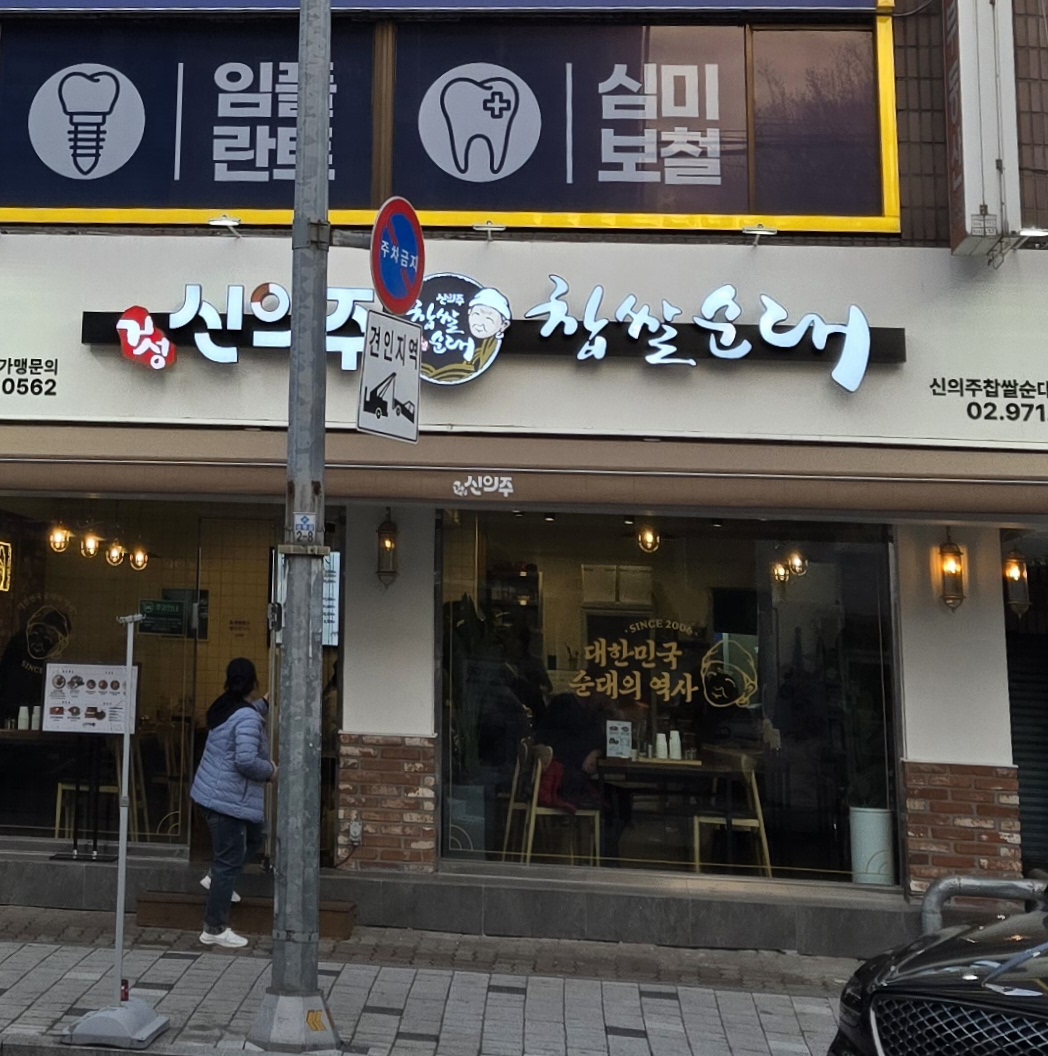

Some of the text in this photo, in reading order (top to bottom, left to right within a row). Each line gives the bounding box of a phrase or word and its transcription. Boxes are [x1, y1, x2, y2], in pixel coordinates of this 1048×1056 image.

[598, 63, 720, 120] 심미
[598, 126, 722, 185] 보철
[380, 240, 419, 273] 주차금지
[369, 325, 420, 371] 견인지역
[464, 475, 514, 497] 신의주
[296, 530, 314, 543] 2-8
[629, 619, 694, 635] SINCE 2006
[584, 638, 683, 669] 대한민국
[568, 670, 699, 702] 순대의 역사
